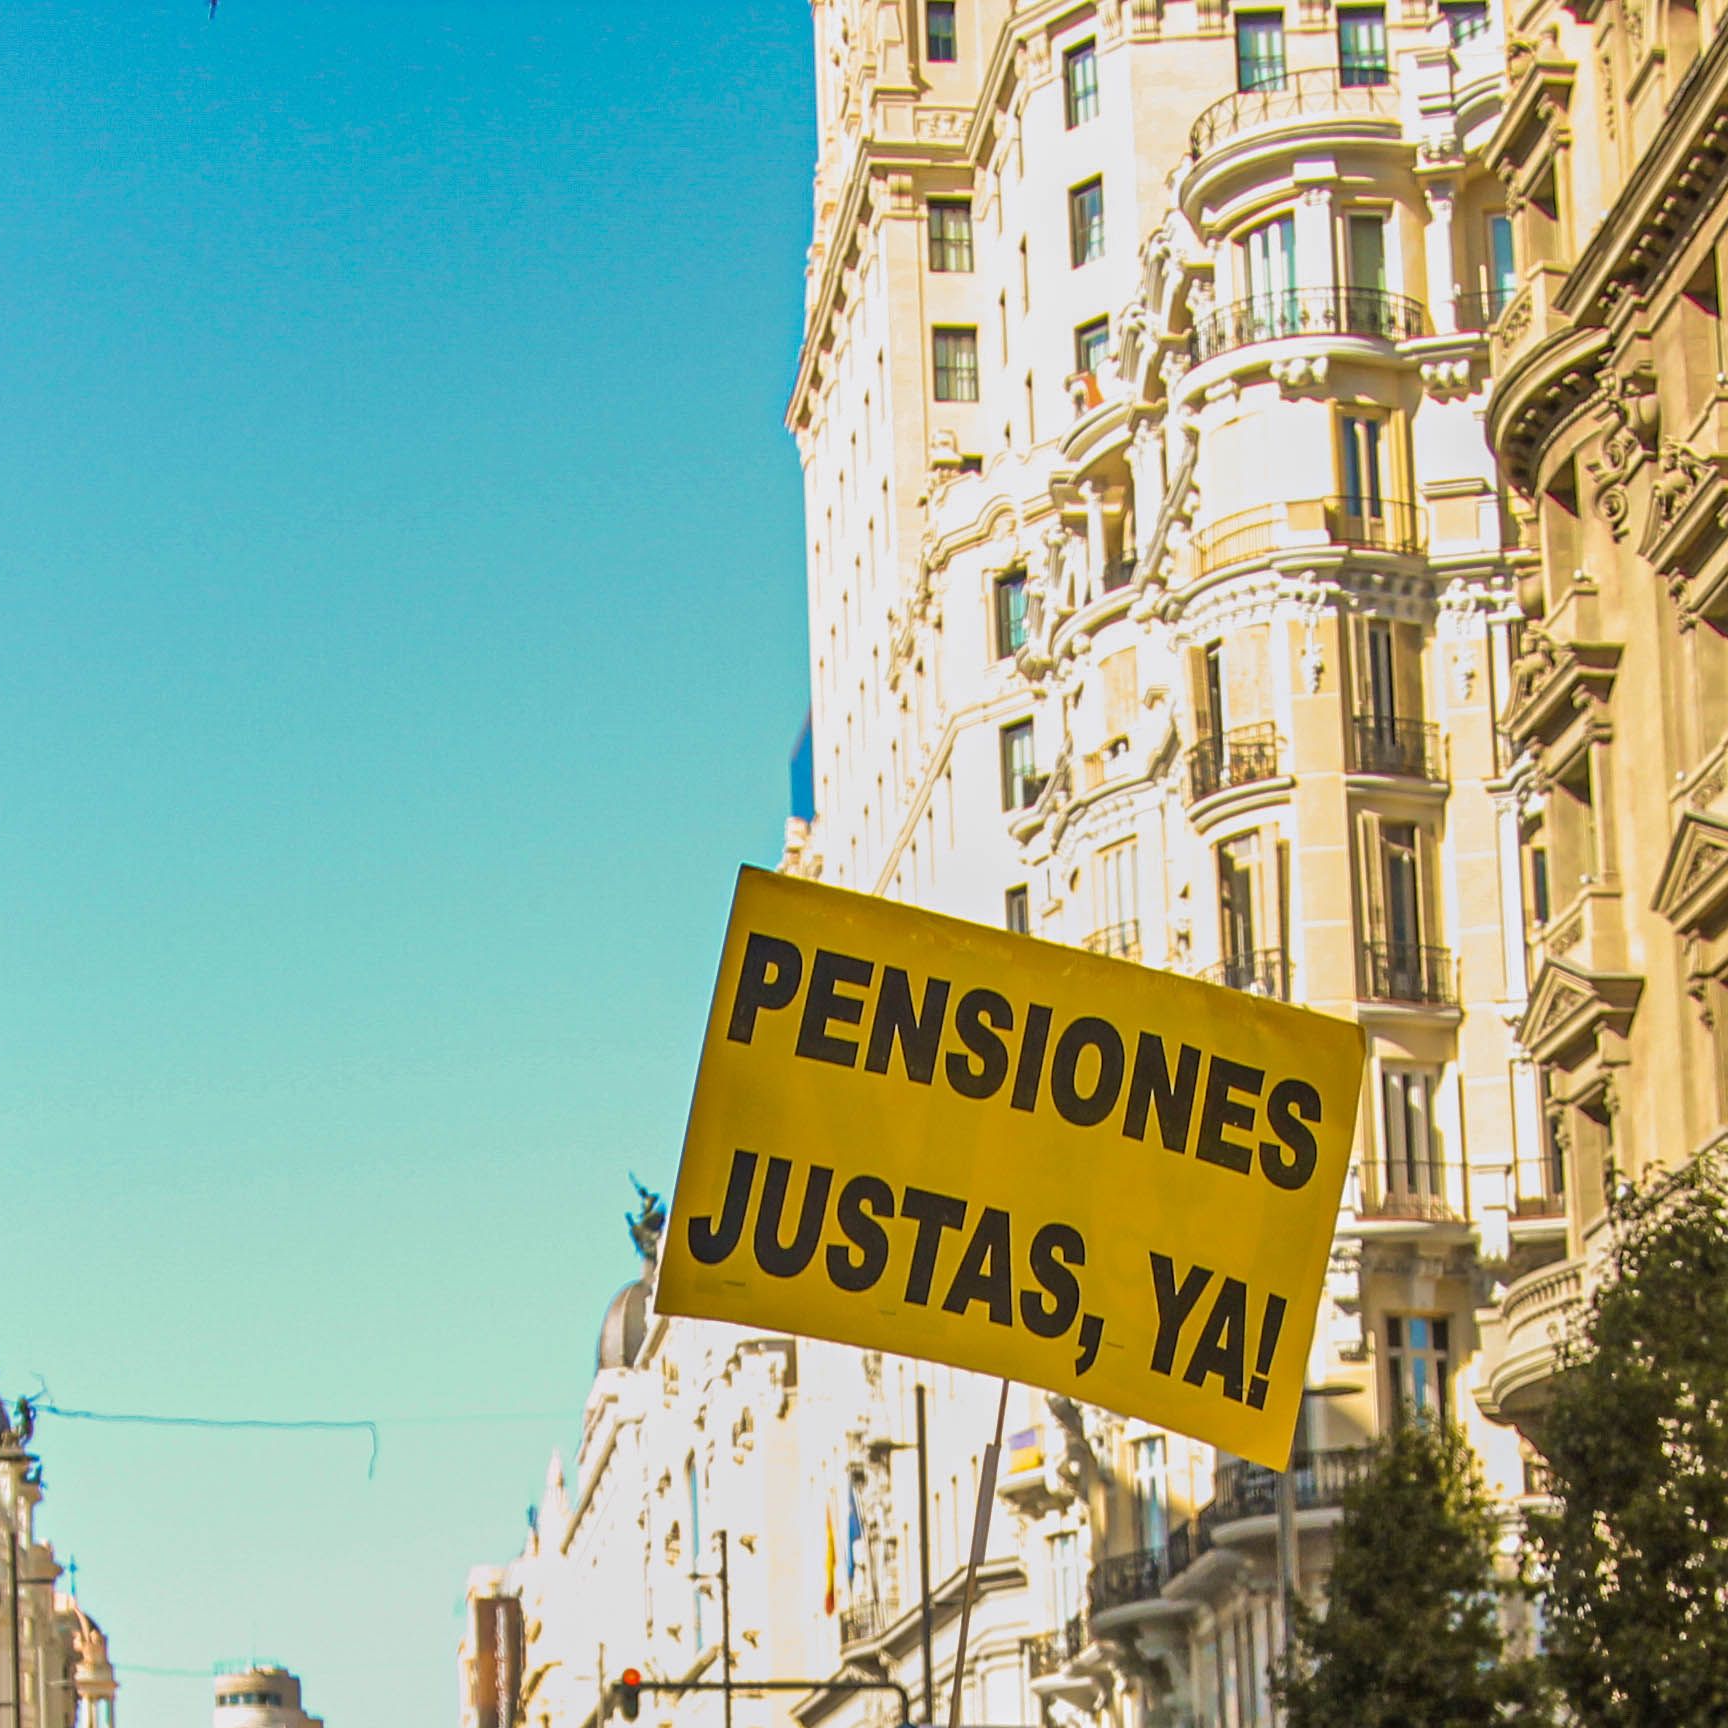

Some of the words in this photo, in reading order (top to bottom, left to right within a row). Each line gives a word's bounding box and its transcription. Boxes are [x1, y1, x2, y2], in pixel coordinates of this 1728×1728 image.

[727, 931, 1321, 1190] PENSIONES
[687, 1149, 1105, 1376] JUSTAS,
[1149, 1250, 1287, 1411] YA!
